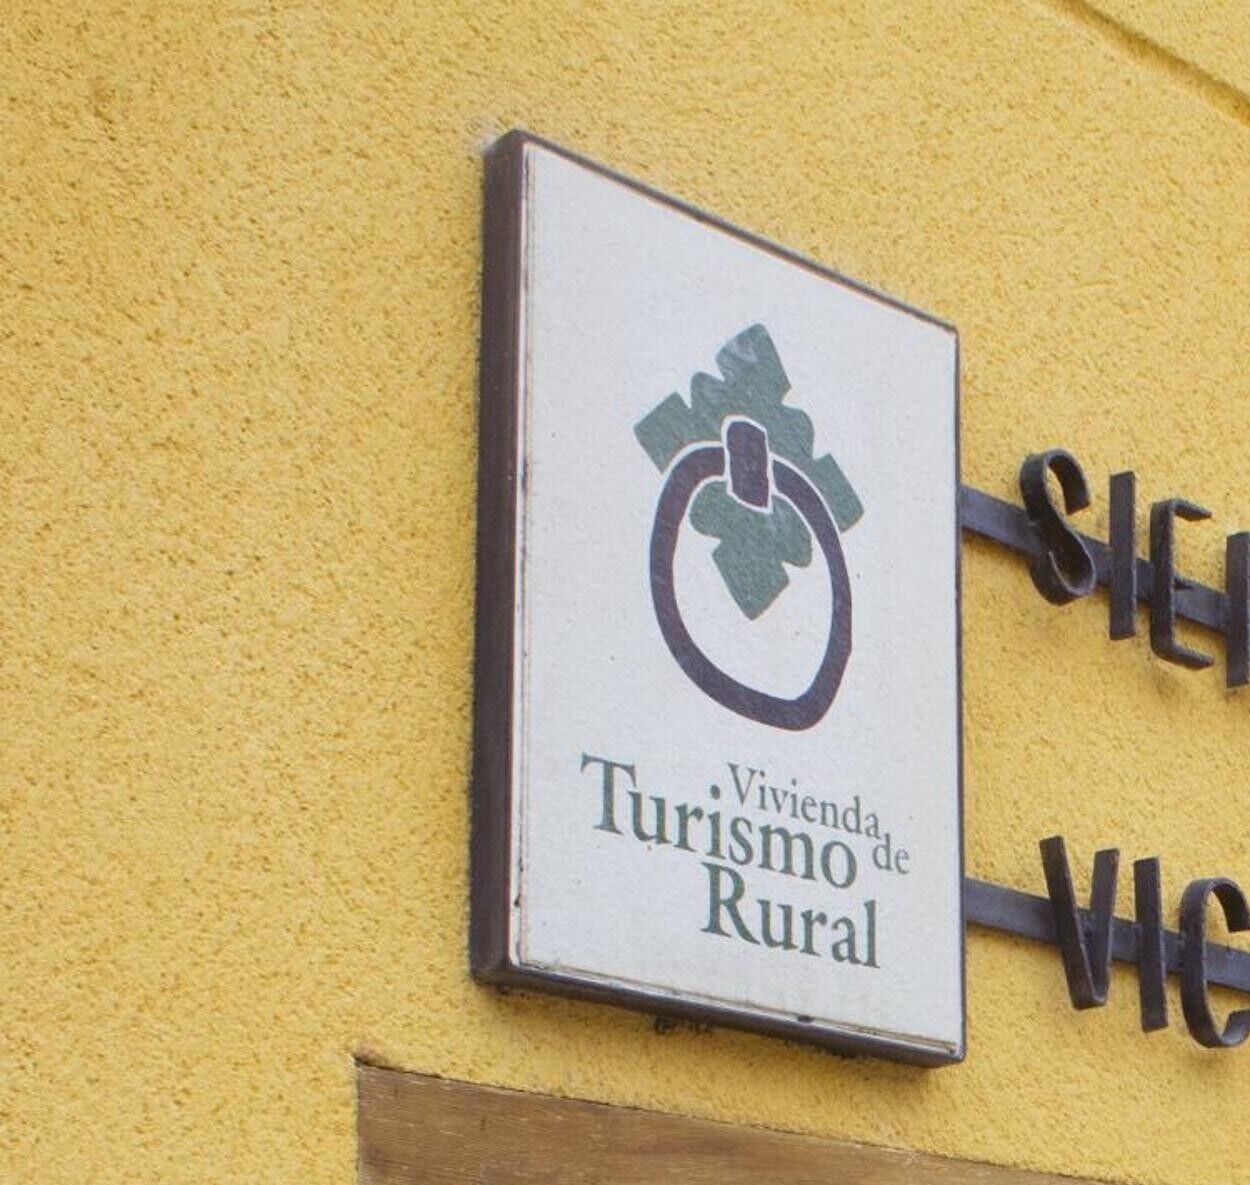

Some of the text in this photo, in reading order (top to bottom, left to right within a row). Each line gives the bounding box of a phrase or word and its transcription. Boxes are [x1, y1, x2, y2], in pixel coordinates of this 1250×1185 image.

[580, 752, 911, 889] Turismo de
[728, 762, 882, 840] Vivienda
[699, 860, 881, 969] Rural
